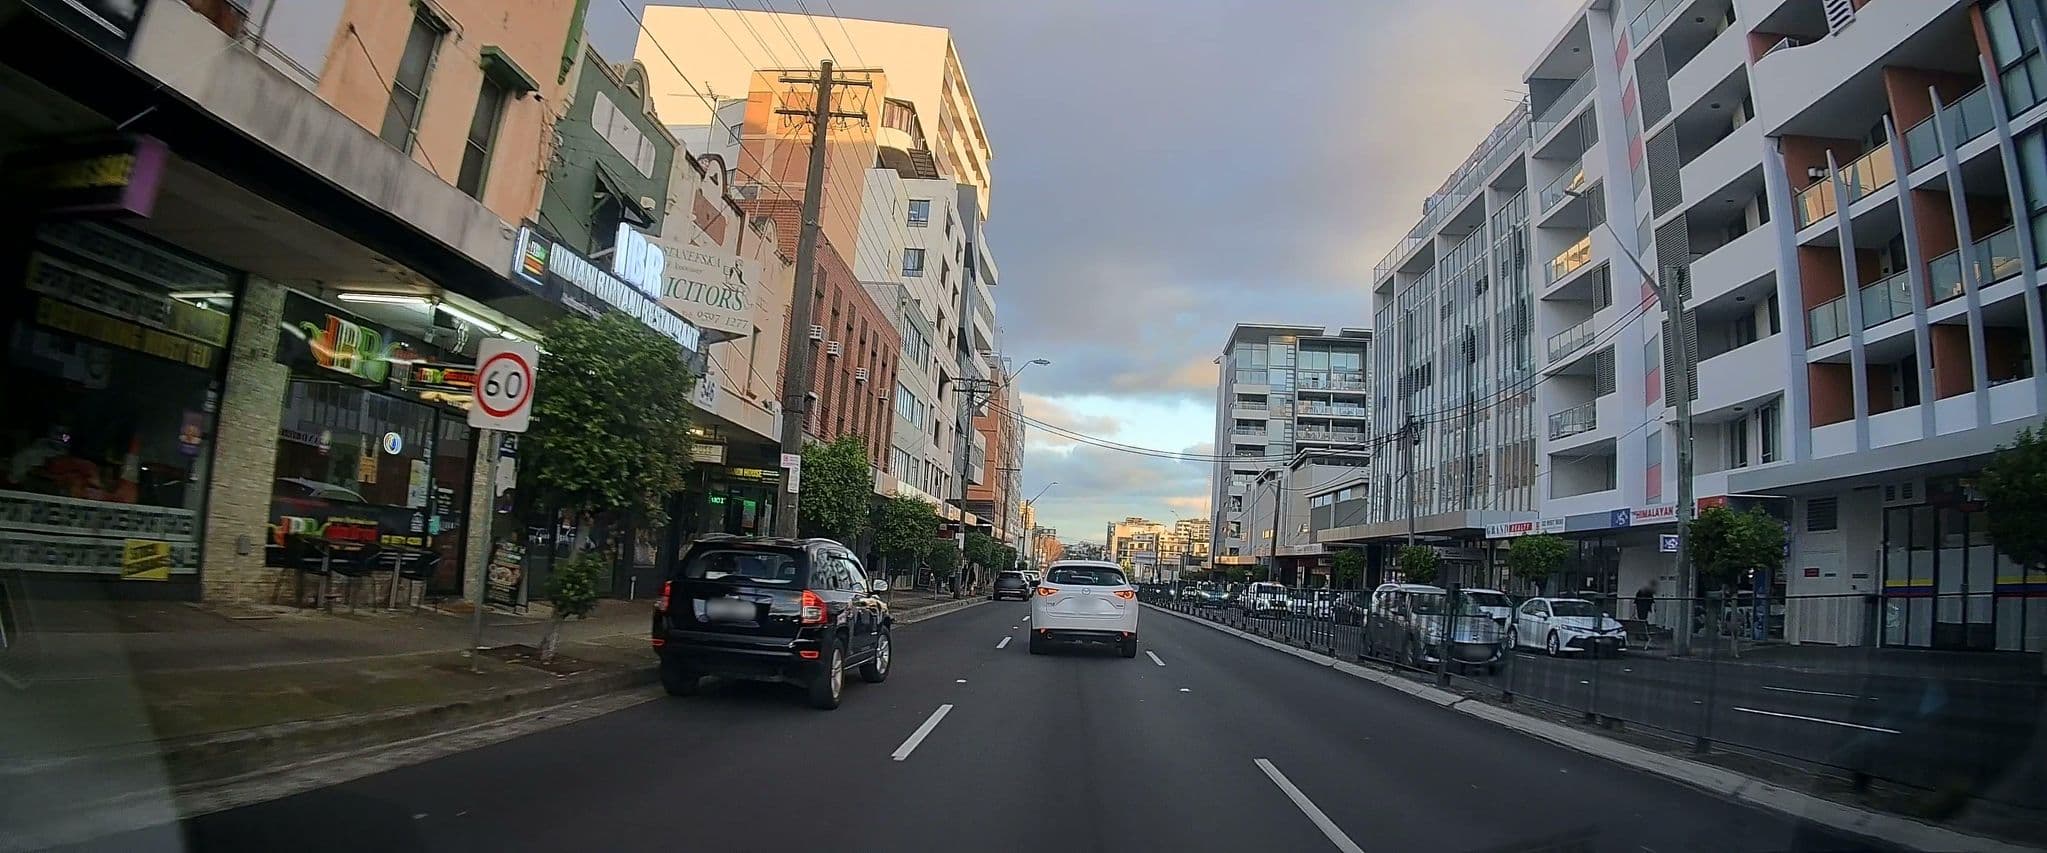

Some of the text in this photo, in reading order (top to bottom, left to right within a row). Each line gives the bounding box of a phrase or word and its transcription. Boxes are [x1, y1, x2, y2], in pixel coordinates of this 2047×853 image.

[549, 242, 598, 296] INDIAN
[641, 299, 701, 353] RESTAURANT
[485, 370, 522, 399] 60
